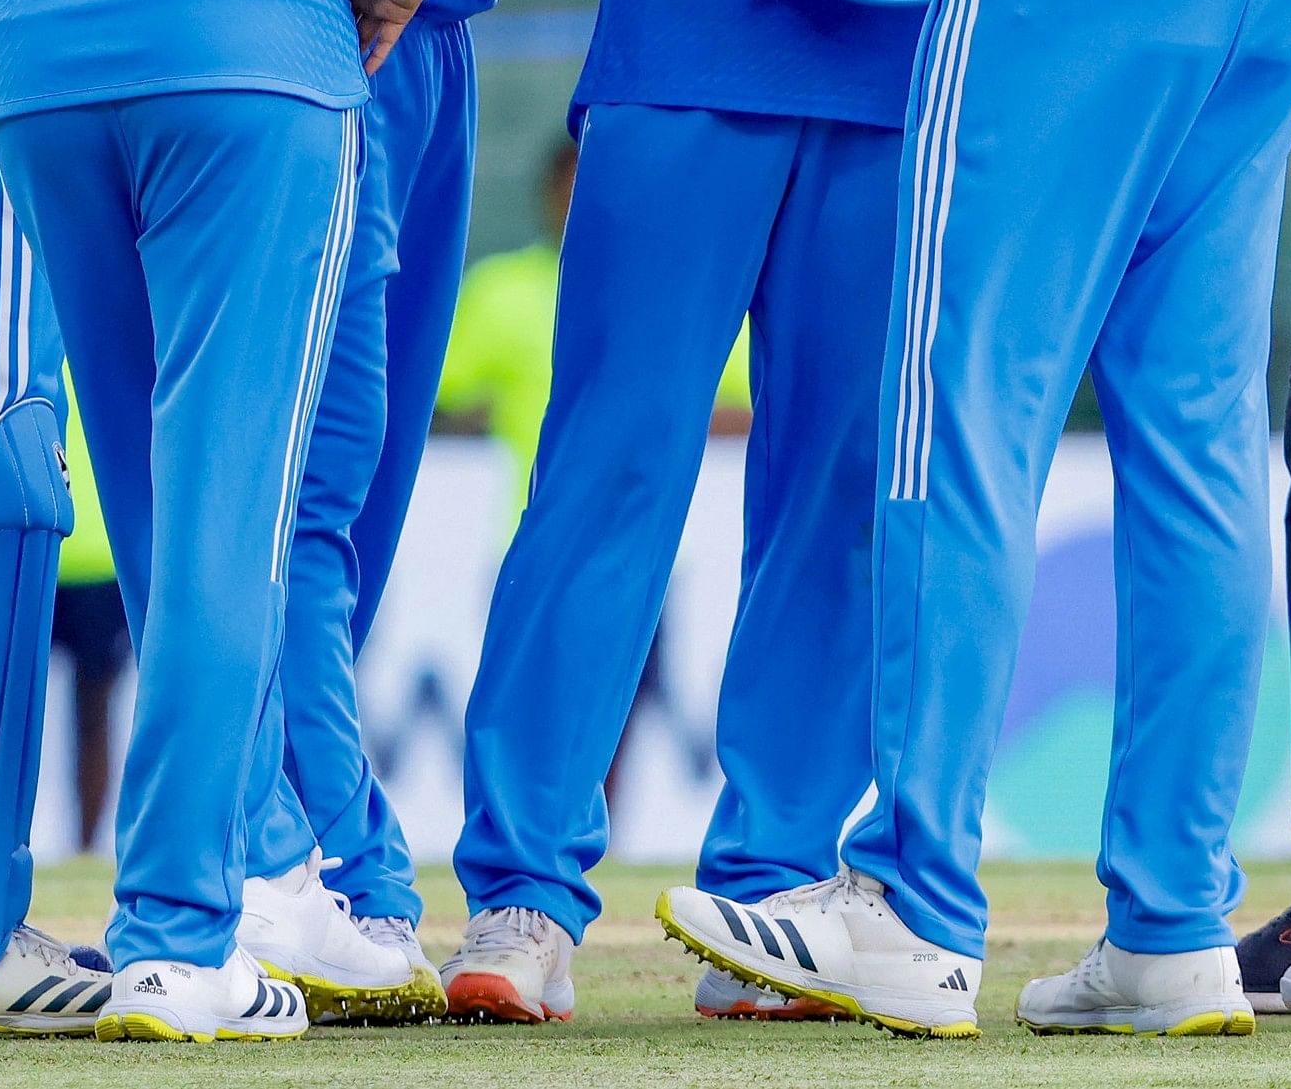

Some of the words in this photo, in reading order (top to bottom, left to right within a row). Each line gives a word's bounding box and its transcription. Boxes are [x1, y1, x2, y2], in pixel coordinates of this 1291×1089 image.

[912, 953, 939, 962] 22YDS
[169, 964, 192, 979] 22YDS
[133, 984, 168, 996] adidas
